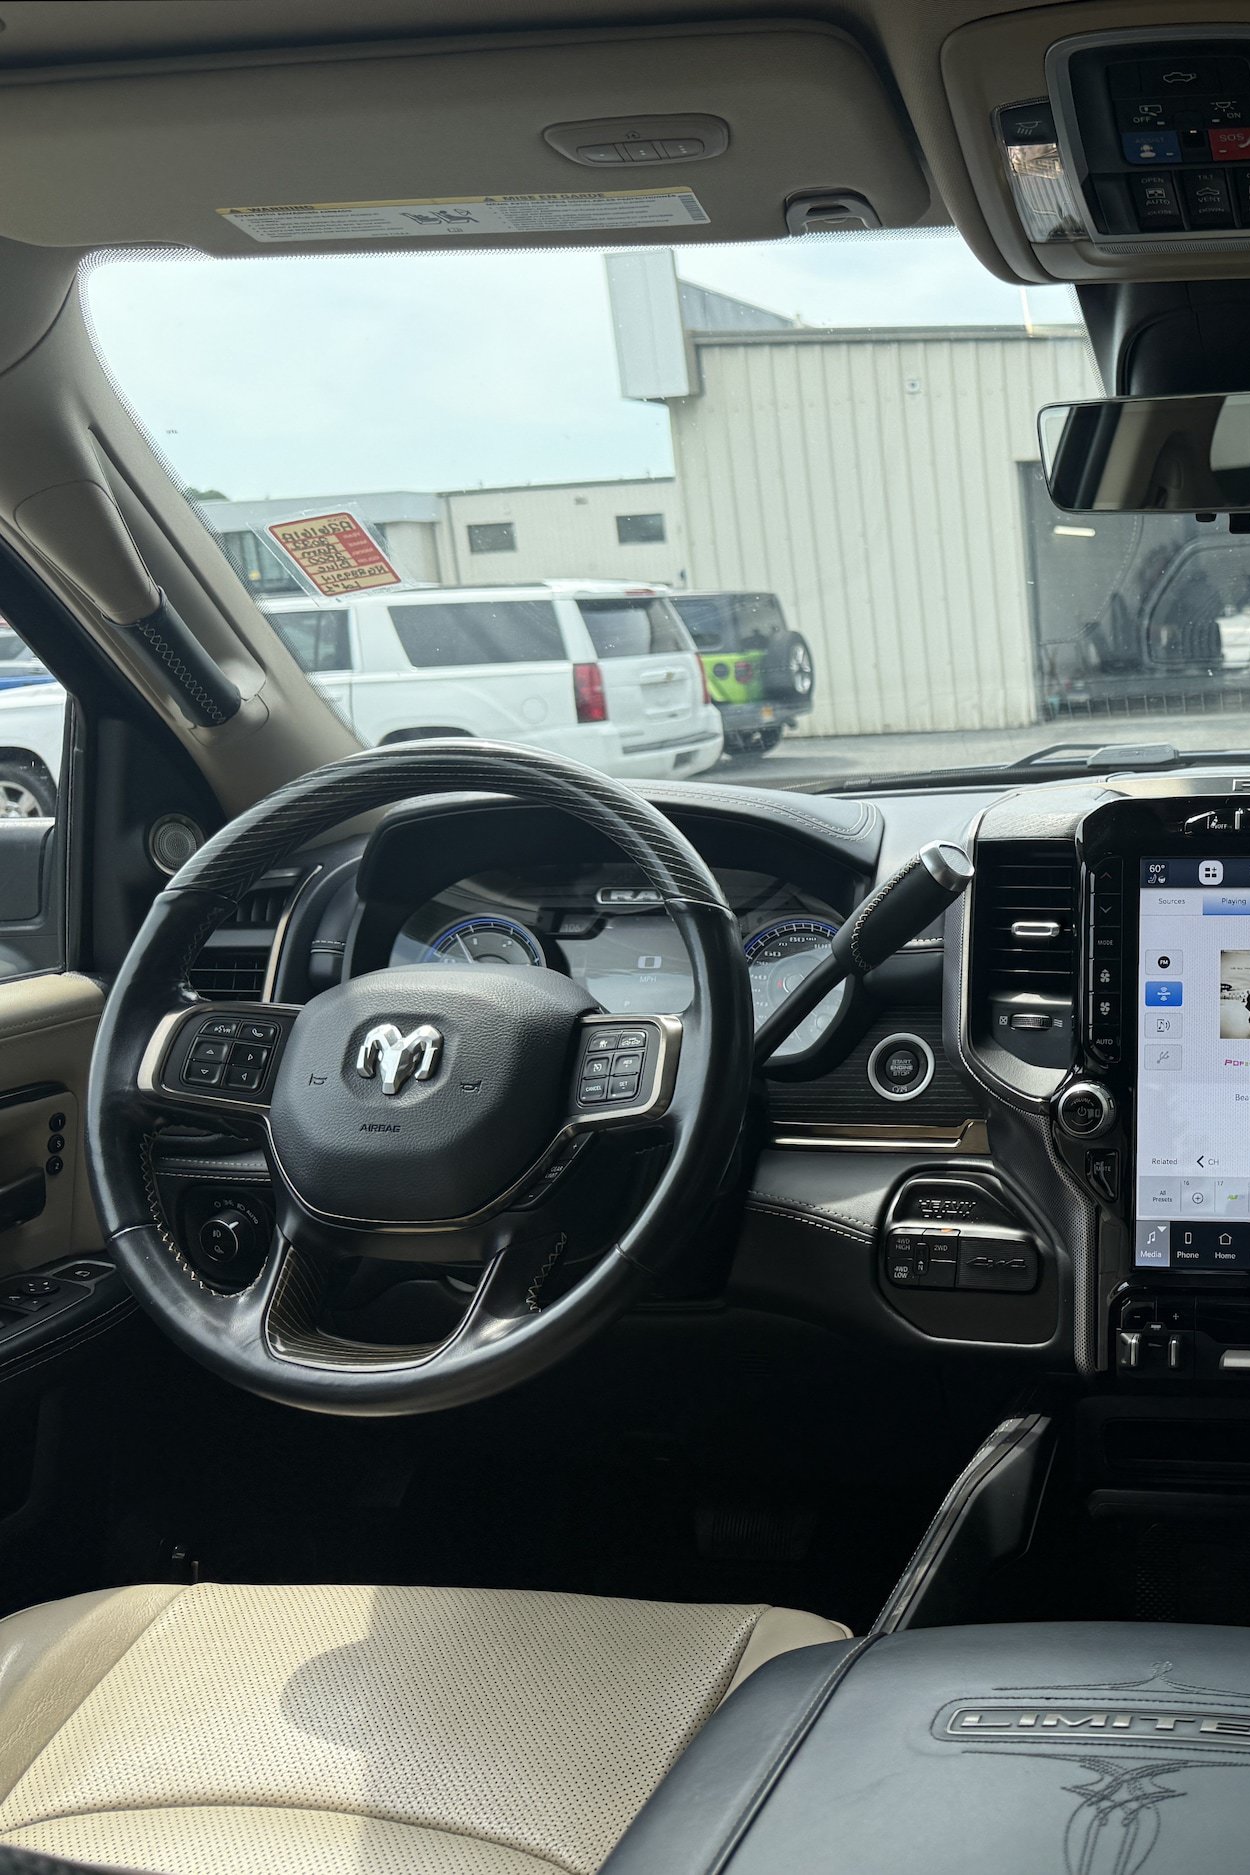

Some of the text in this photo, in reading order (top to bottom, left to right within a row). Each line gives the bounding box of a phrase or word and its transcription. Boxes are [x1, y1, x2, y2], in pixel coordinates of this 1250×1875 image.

[1219, 133, 1244, 142] SOS
[1149, 864, 1166, 873] 60°
[1158, 897, 1186, 905] Sources
[1221, 897, 1247, 906] Playing
[585, 1084, 602, 1092] CANCEL
[360, 1123, 401, 1133] AIRBAG
[1151, 1157, 1178, 1165] Related
[1208, 1158, 1219, 1166] CH
[1176, 1251, 1199, 1259] Phone
[1214, 1252, 1236, 1260] Home
